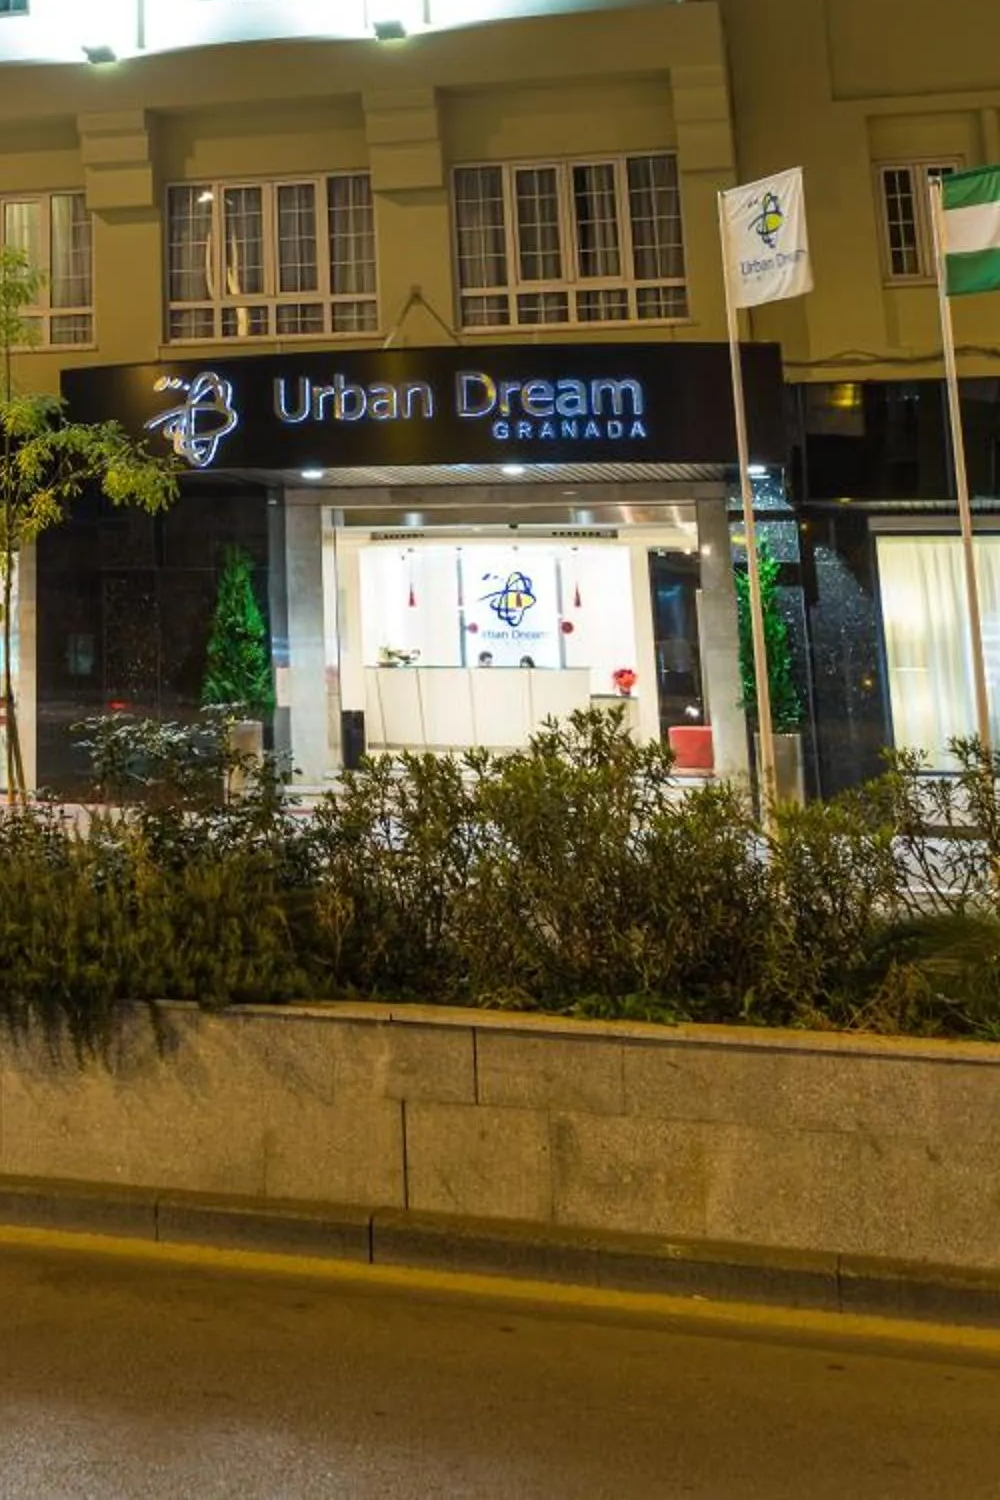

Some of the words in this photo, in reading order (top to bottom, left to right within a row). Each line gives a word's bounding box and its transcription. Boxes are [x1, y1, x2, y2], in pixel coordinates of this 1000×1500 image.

[274, 373, 433, 422] Urban
[456, 370, 643, 418] Dream
[492, 420, 647, 440] GRANADA
